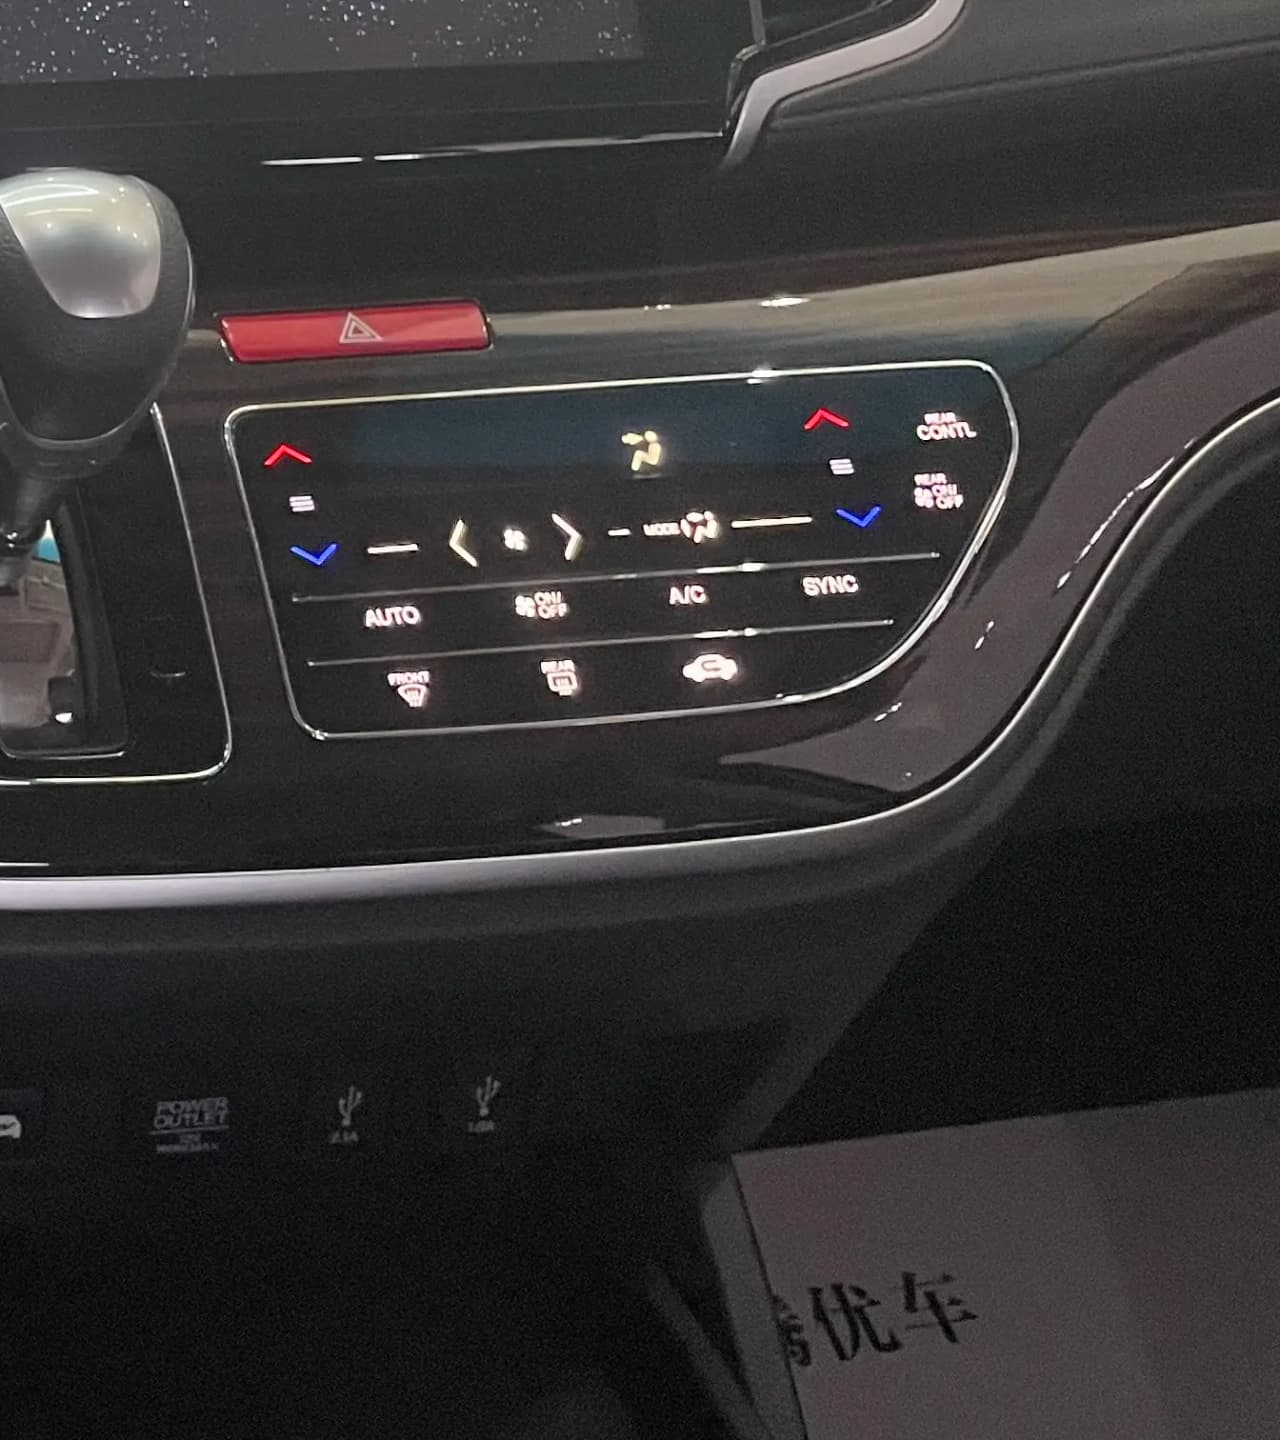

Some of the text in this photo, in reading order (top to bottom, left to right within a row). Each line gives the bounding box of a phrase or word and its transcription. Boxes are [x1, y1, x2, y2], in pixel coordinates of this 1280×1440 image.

[916, 421, 977, 441] CONTL
[668, 585, 706, 605] A/C
[802, 574, 858, 596] SYNC
[364, 605, 421, 628] AUTO
[387, 670, 430, 686] FRONT
[156, 1097, 229, 1117] POWER
[153, 1112, 227, 1131] OUTLET
